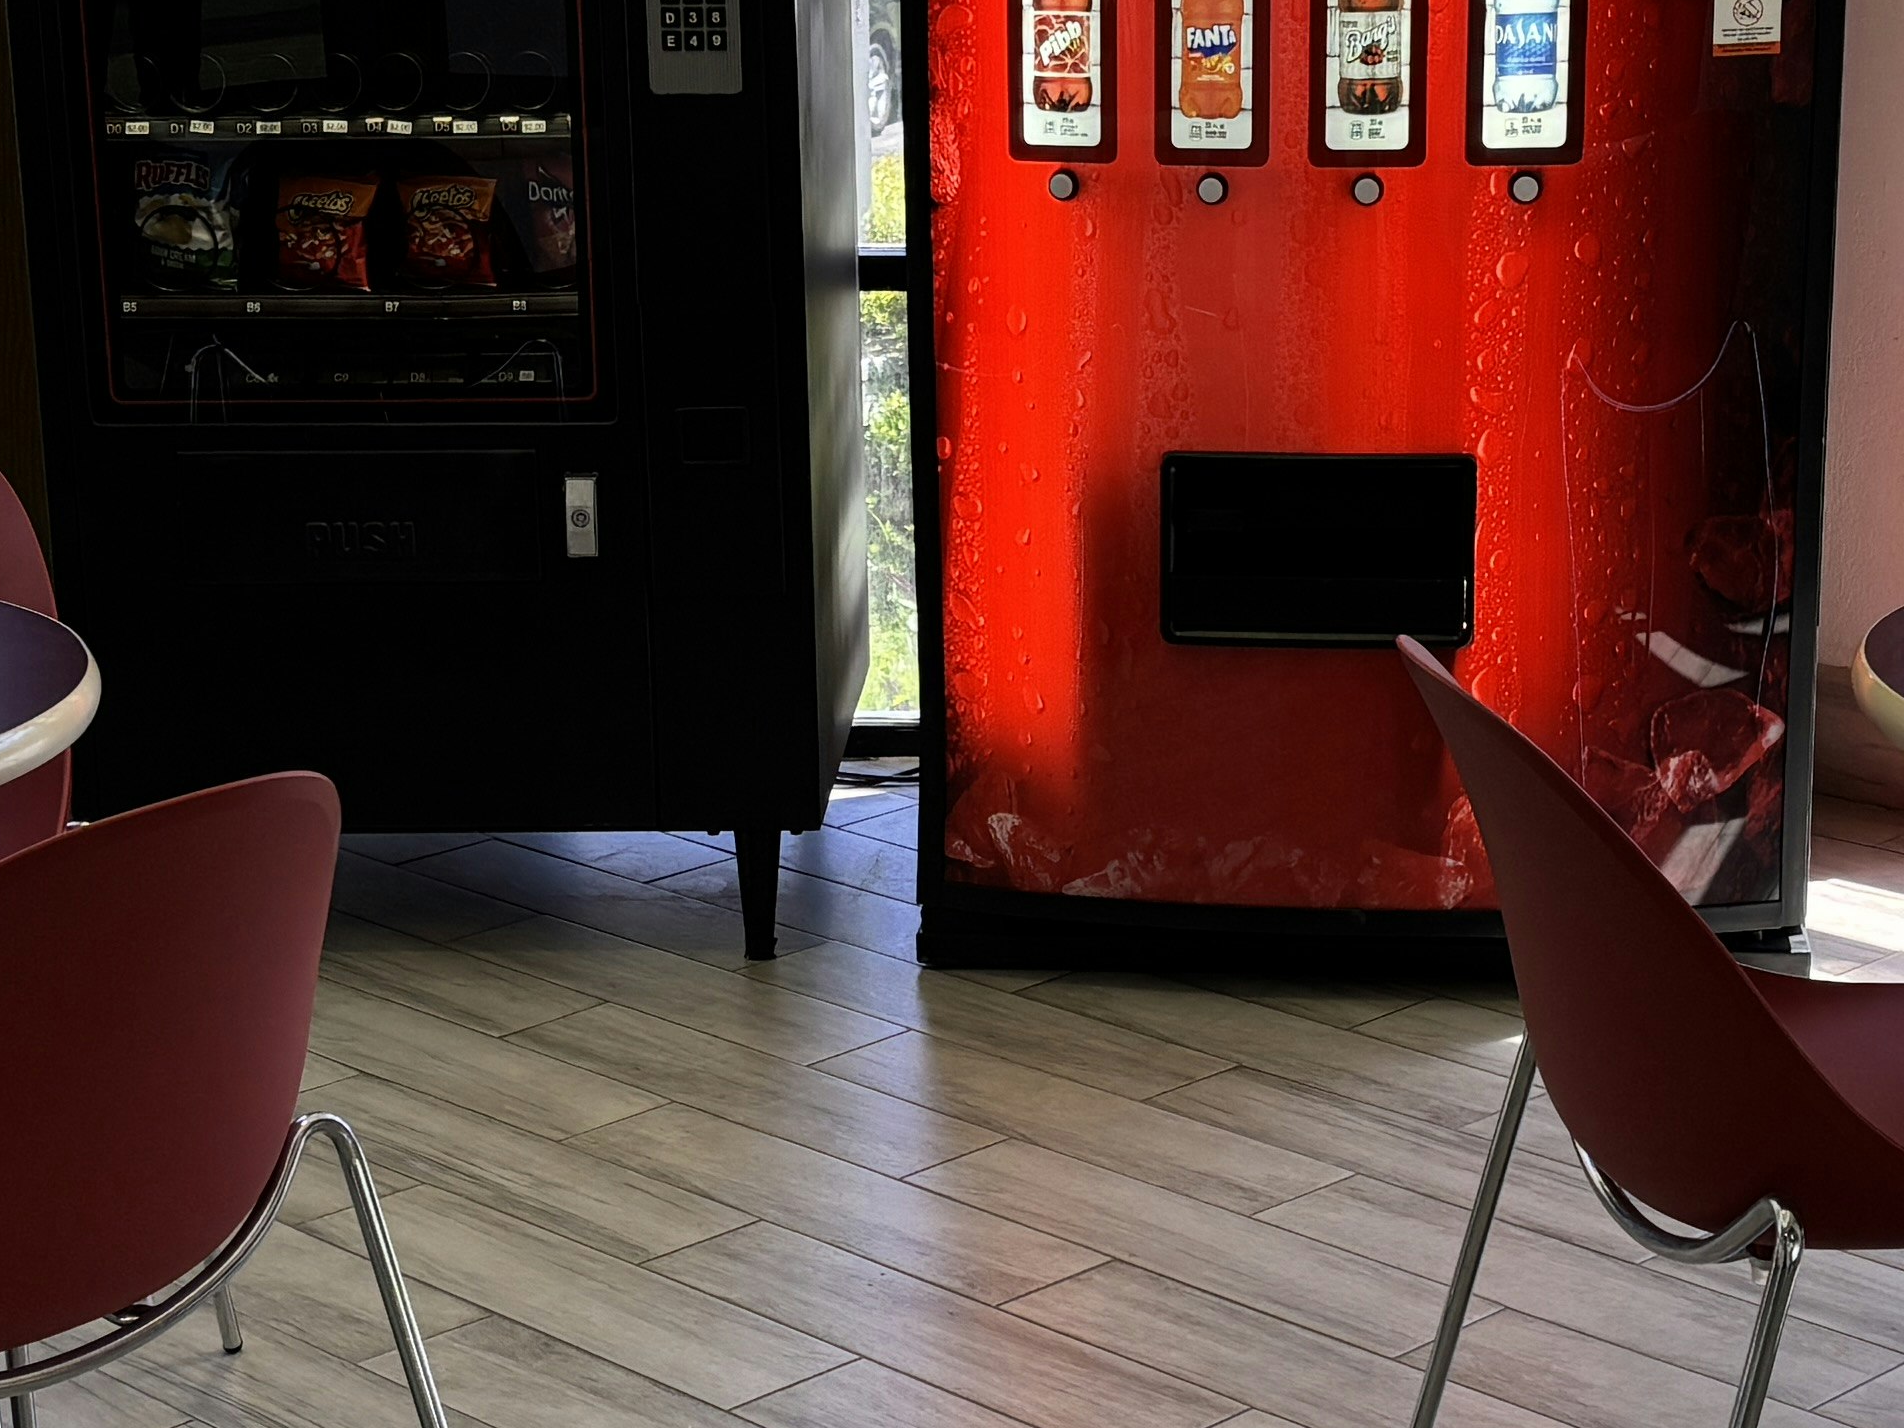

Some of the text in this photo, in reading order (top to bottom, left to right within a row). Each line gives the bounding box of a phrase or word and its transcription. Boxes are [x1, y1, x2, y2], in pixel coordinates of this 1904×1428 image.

[665, 12, 720, 24] D 3 8
[667, 35, 721, 47] E 4 9
[1039, 20, 1082, 66] Pibb
[1187, 25, 1236, 49] FANTA
[1345, 15, 1396, 64] Barq's
[106, 123, 122, 134] D0
[170, 123, 184, 134] D1
[237, 122, 252, 133] D2
[302, 122, 318, 133] D3
[435, 122, 450, 133] D5
[136, 160, 210, 190] RUFFLES
[122, 301, 137, 313] B5
[246, 301, 261, 313] B6
[385, 301, 400, 313] B7
[305, 521, 417, 557] PUSH
